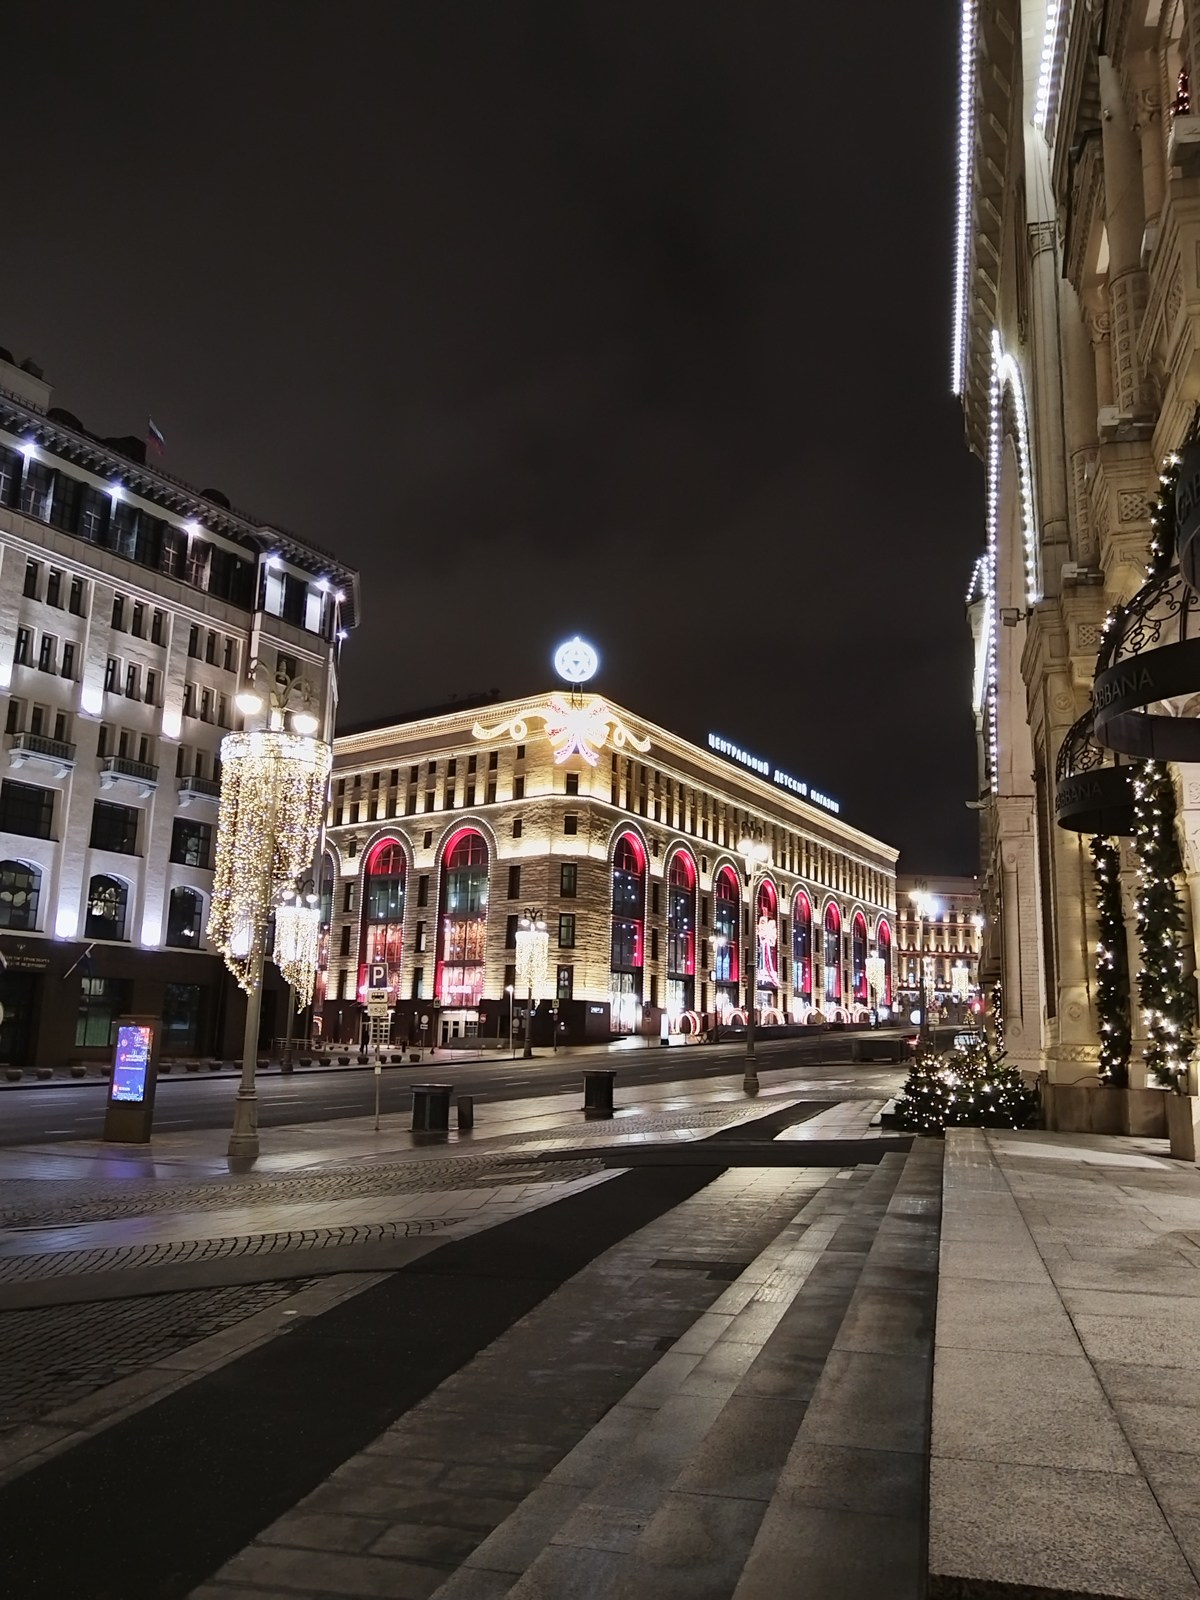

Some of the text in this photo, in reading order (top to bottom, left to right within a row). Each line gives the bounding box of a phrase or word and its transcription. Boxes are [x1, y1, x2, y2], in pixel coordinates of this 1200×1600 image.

[708, 733, 840, 814] ЦЕНТРАЛЬНЫЙ ДЕТСКИЙ МАГАЗИН
[373, 966, 384, 986] P
